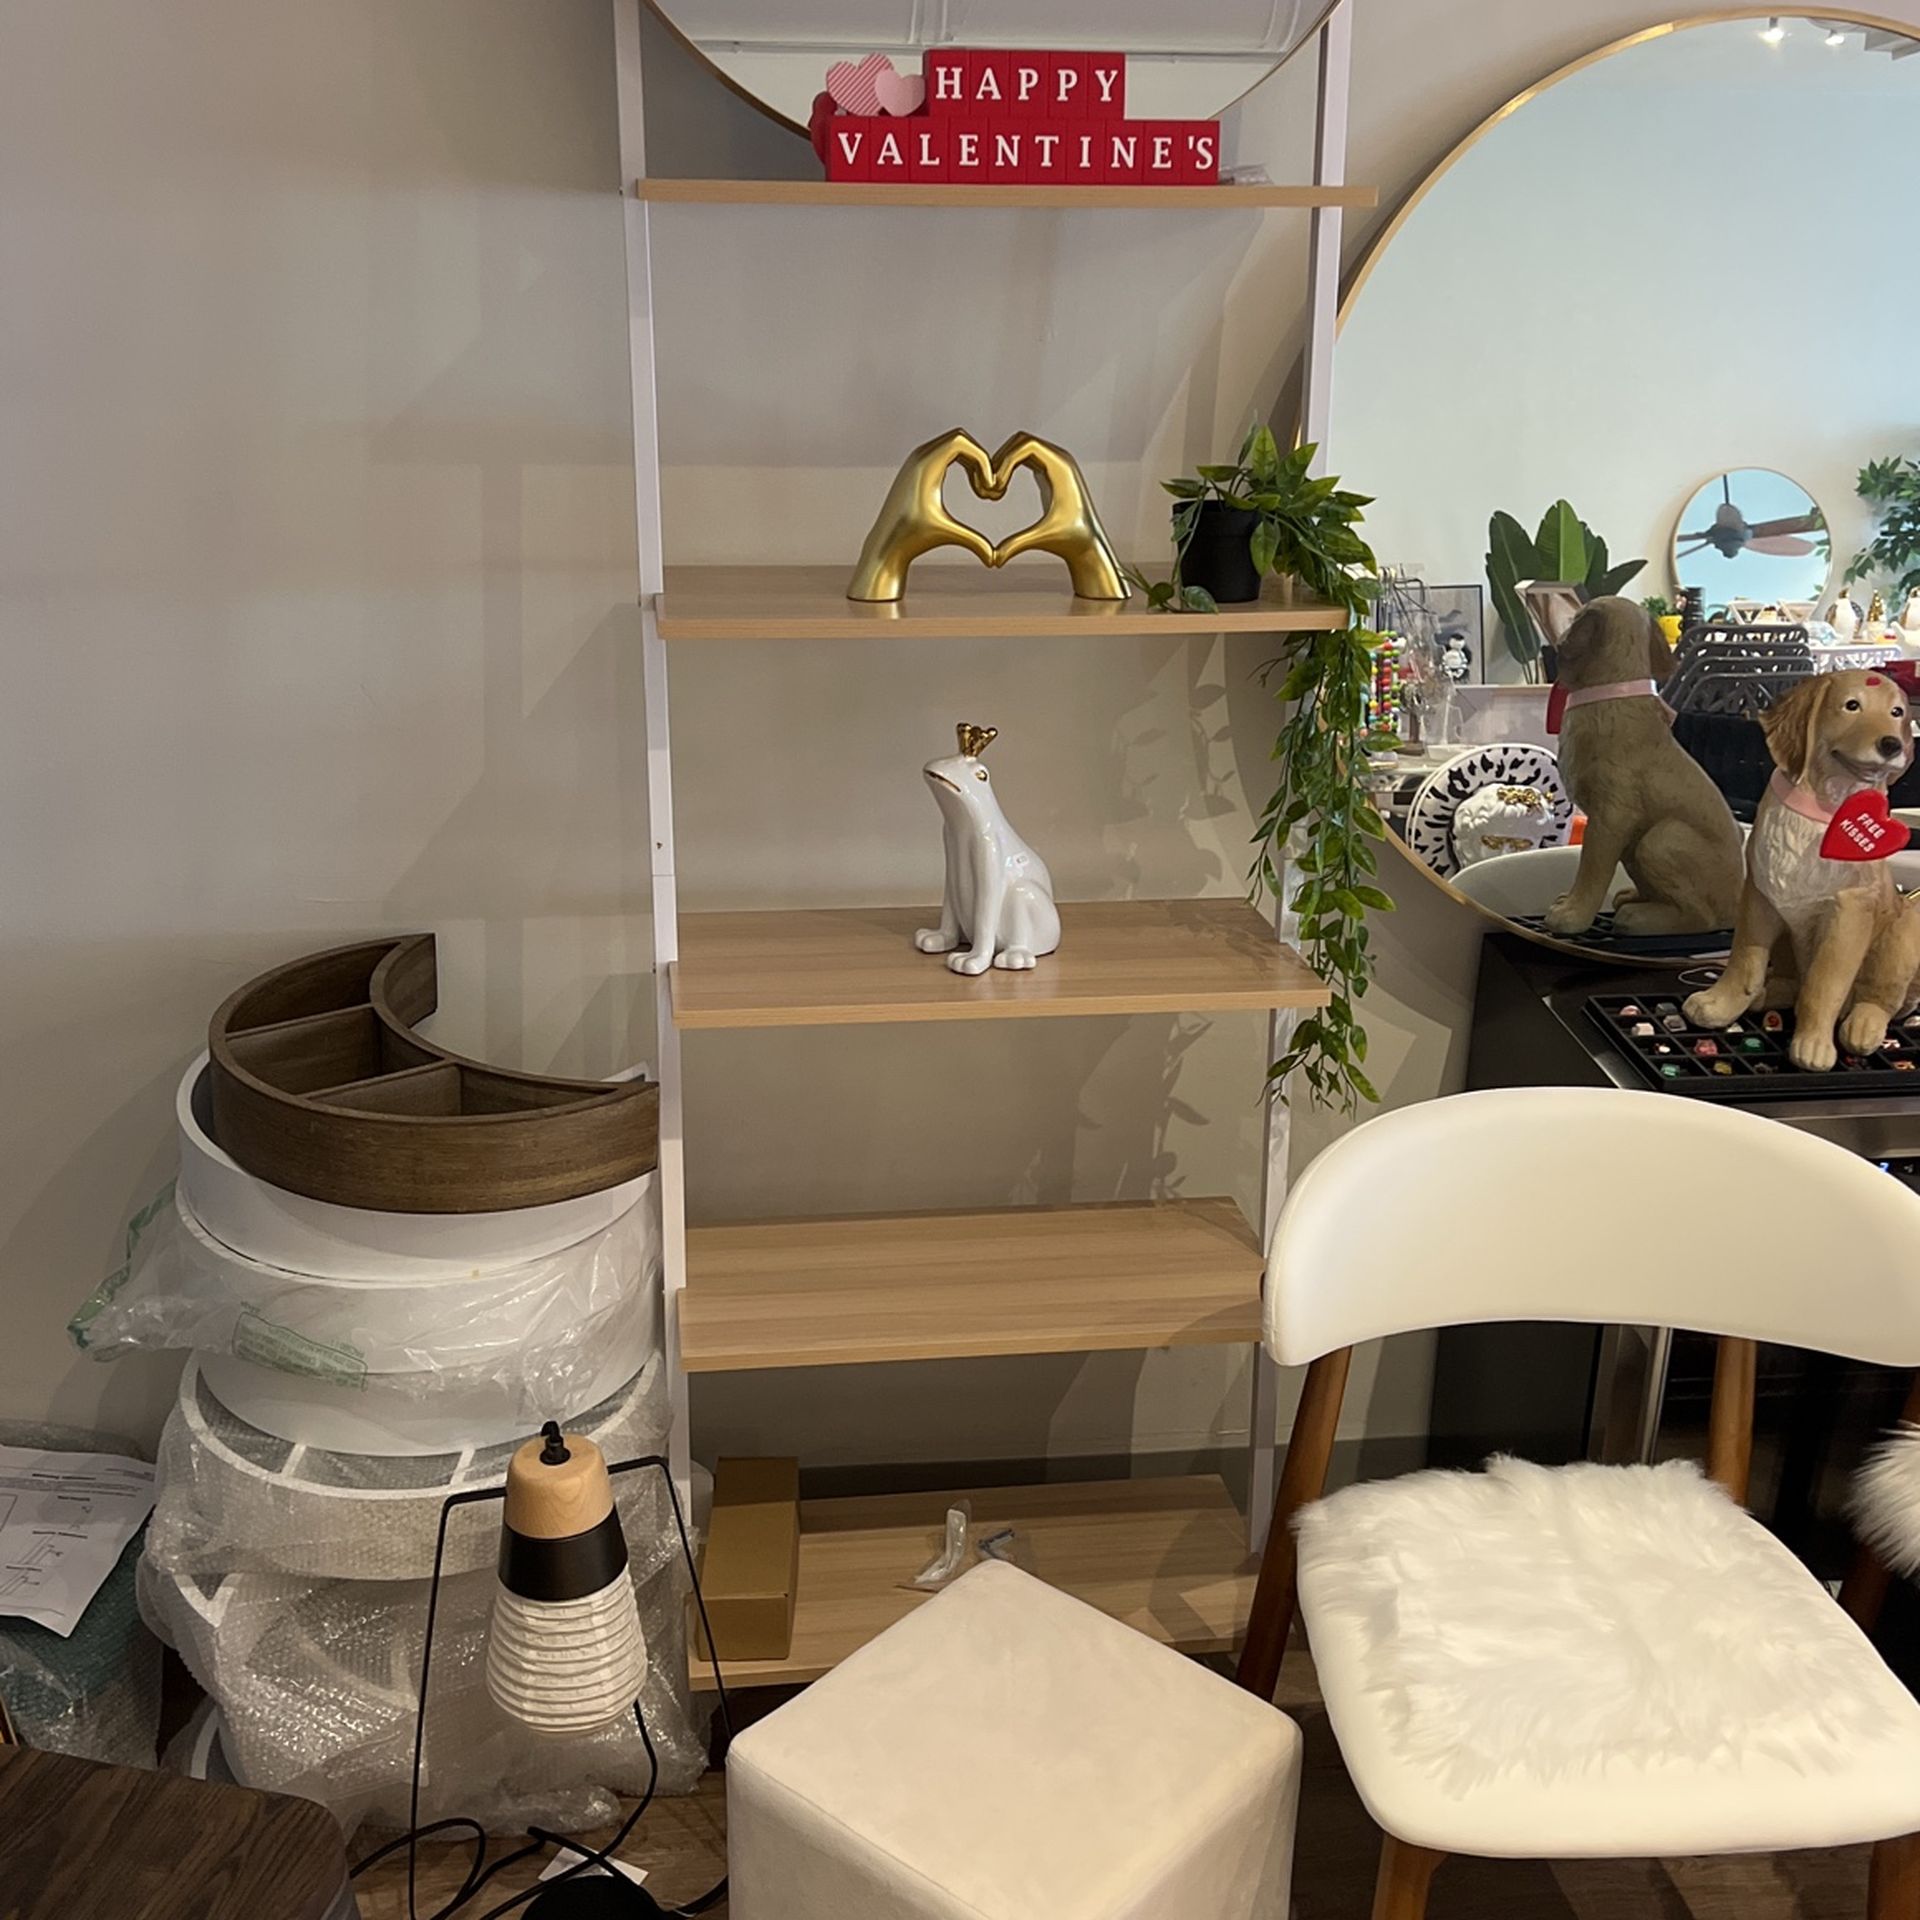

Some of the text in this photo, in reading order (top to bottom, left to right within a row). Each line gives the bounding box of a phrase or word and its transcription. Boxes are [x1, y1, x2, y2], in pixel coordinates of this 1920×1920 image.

[935, 66, 1118, 102] HAPPY
[838, 132, 1214, 170] VALENTINE'S
[1840, 819, 1875, 852] KISSES
[1857, 813, 1885, 838] FREE
